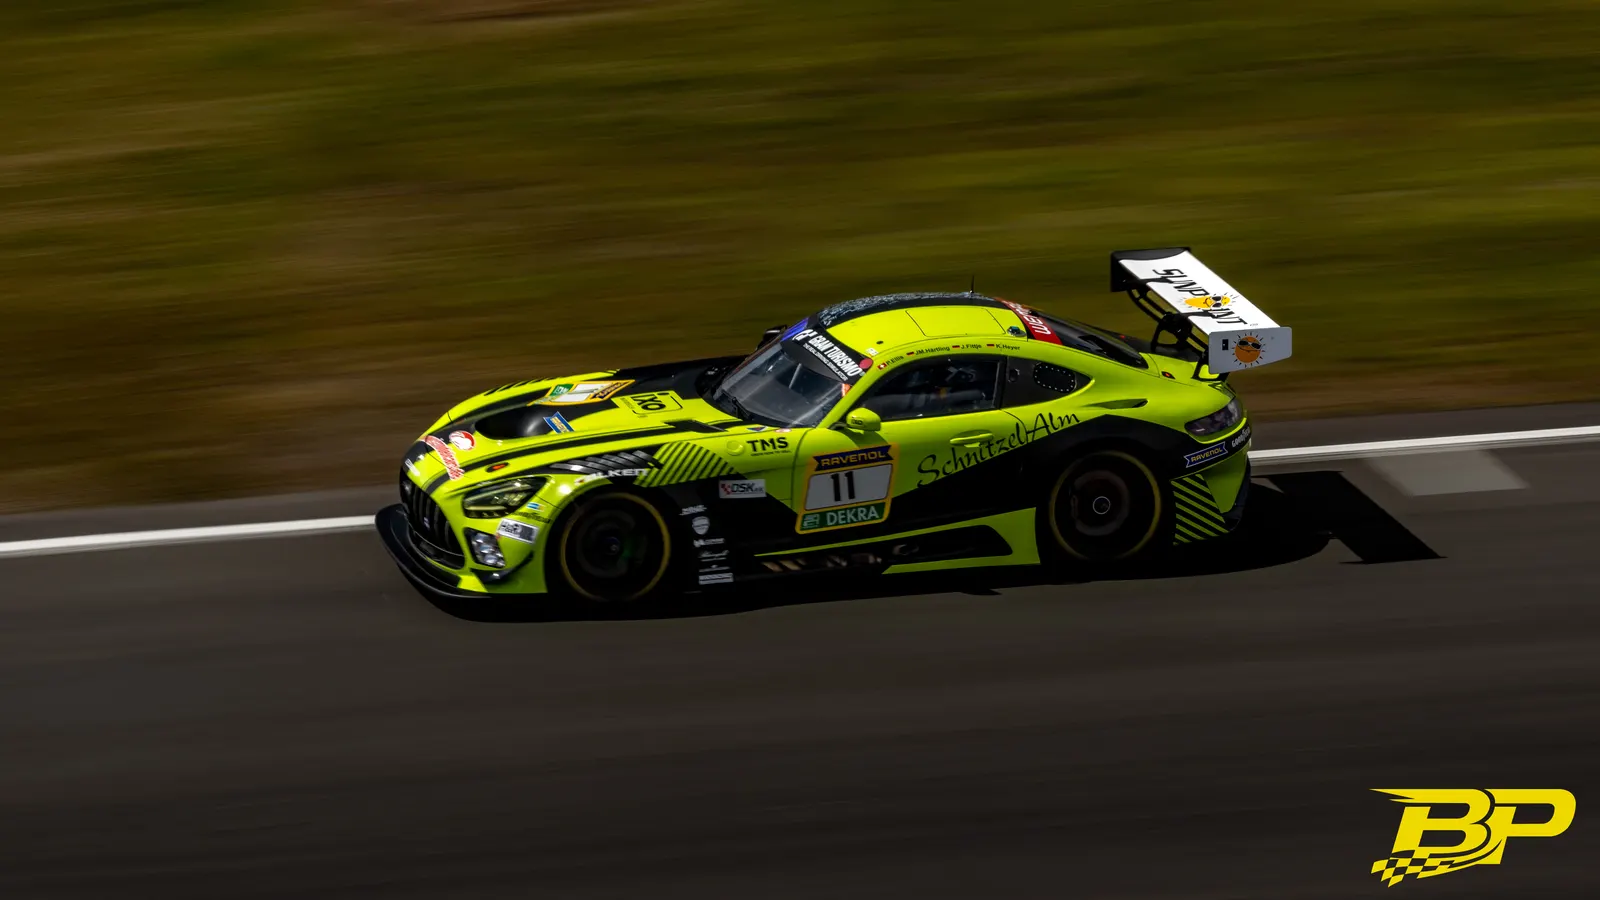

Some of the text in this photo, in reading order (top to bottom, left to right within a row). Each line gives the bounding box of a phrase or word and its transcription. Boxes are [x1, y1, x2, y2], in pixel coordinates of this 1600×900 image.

[808, 335, 863, 377] GRAN TURISMO
[746, 436, 788, 452] TMS
[821, 450, 886, 467] RAVENOL
[1190, 447, 1223, 463] RAVENOL
[830, 470, 856, 502] 11
[826, 505, 880, 526] DEKRA
